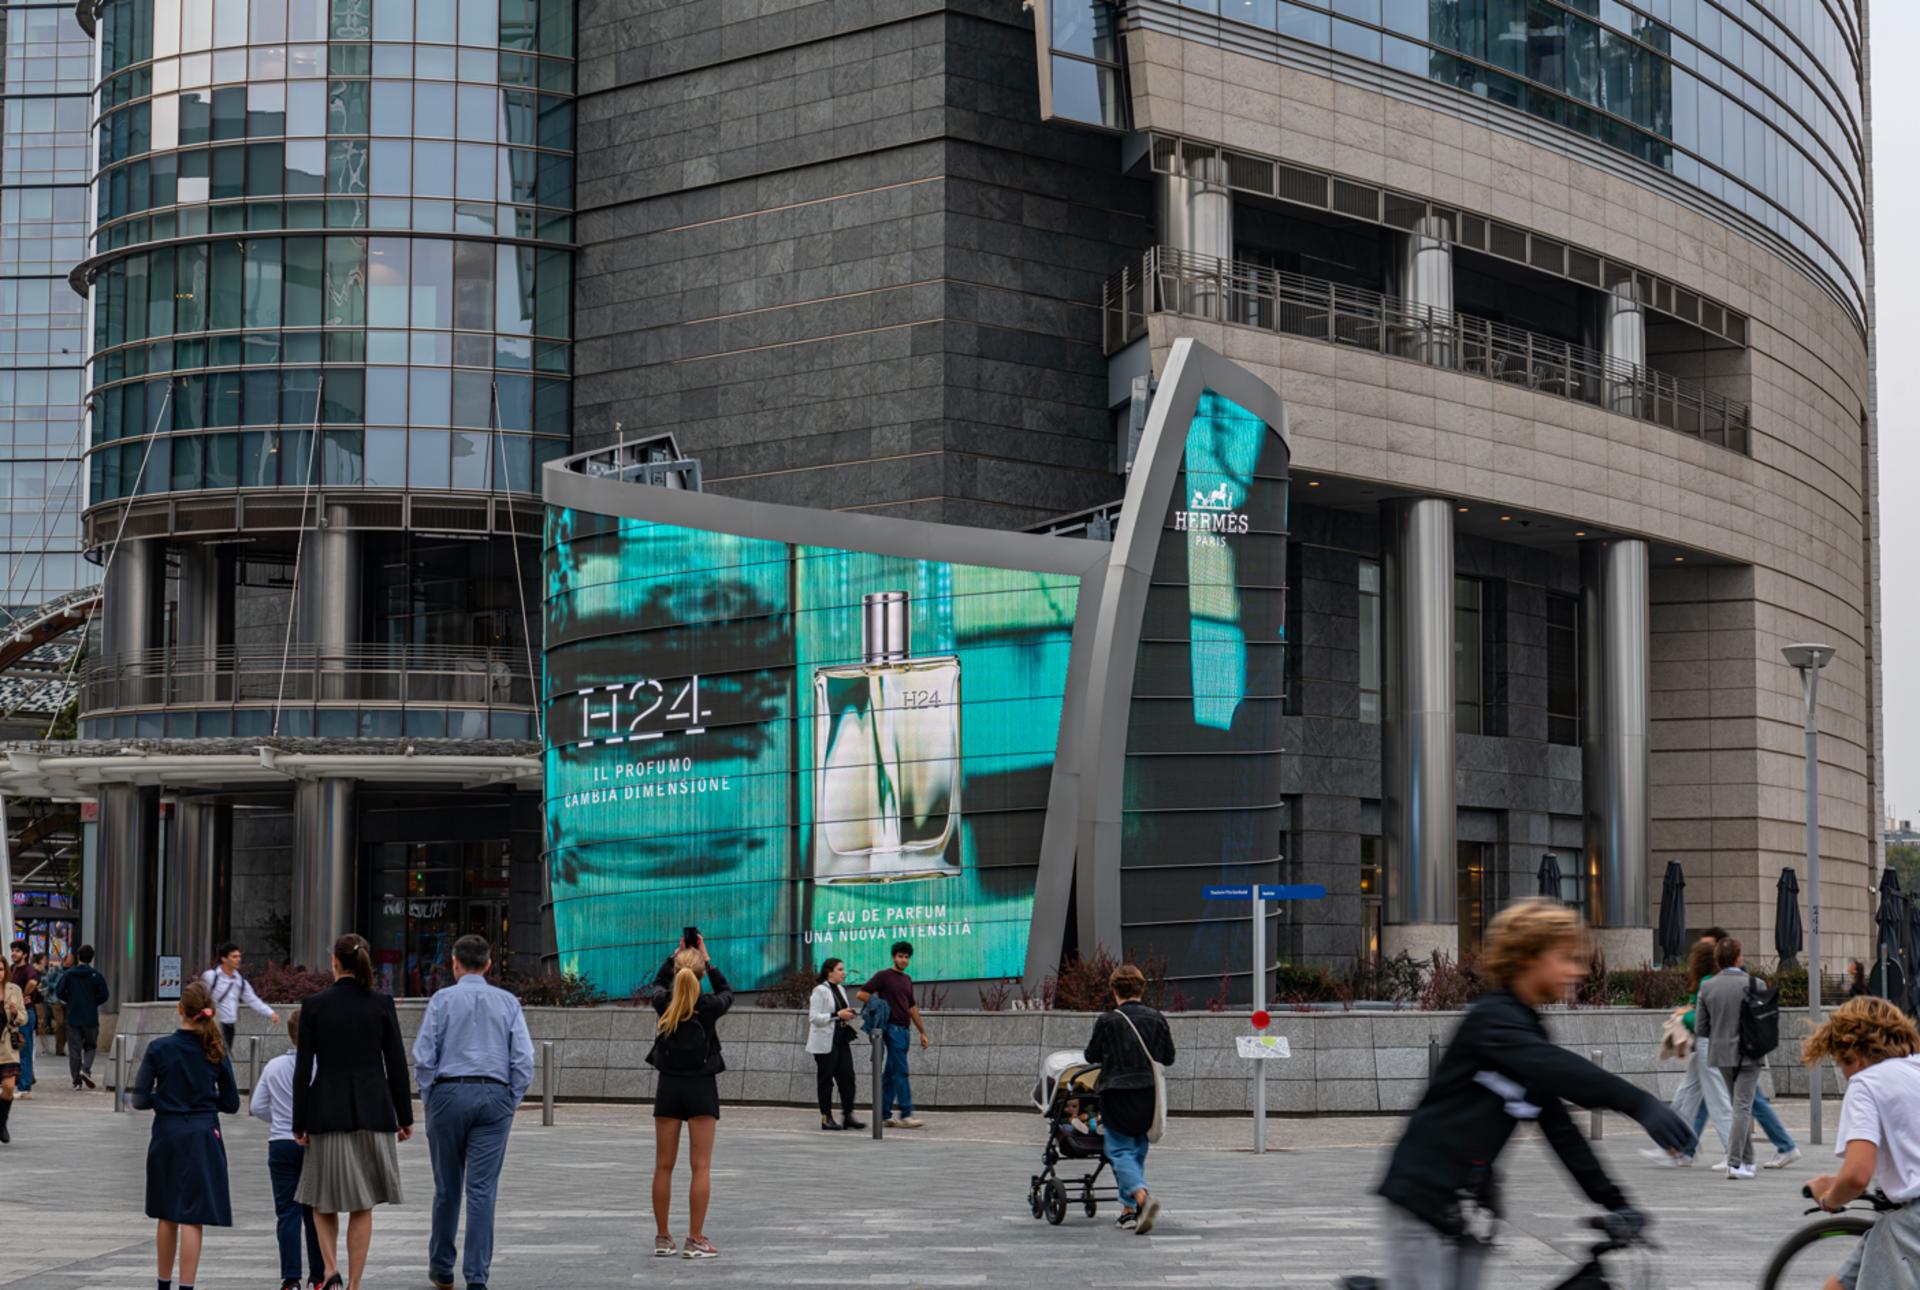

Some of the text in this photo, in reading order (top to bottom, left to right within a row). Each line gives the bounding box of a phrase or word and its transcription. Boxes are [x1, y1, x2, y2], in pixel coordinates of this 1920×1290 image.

[1195, 535, 1227, 548] PARIS
[578, 674, 712, 748] H24
[902, 690, 942, 709] H24
[593, 756, 692, 782] IL PROFUMO
[564, 776, 731, 808] CAMBIA DIMENSIONE
[827, 904, 947, 924] EAU DE PARFUM
[804, 917, 972, 944] UNA NUOVA INTENSITÀ
